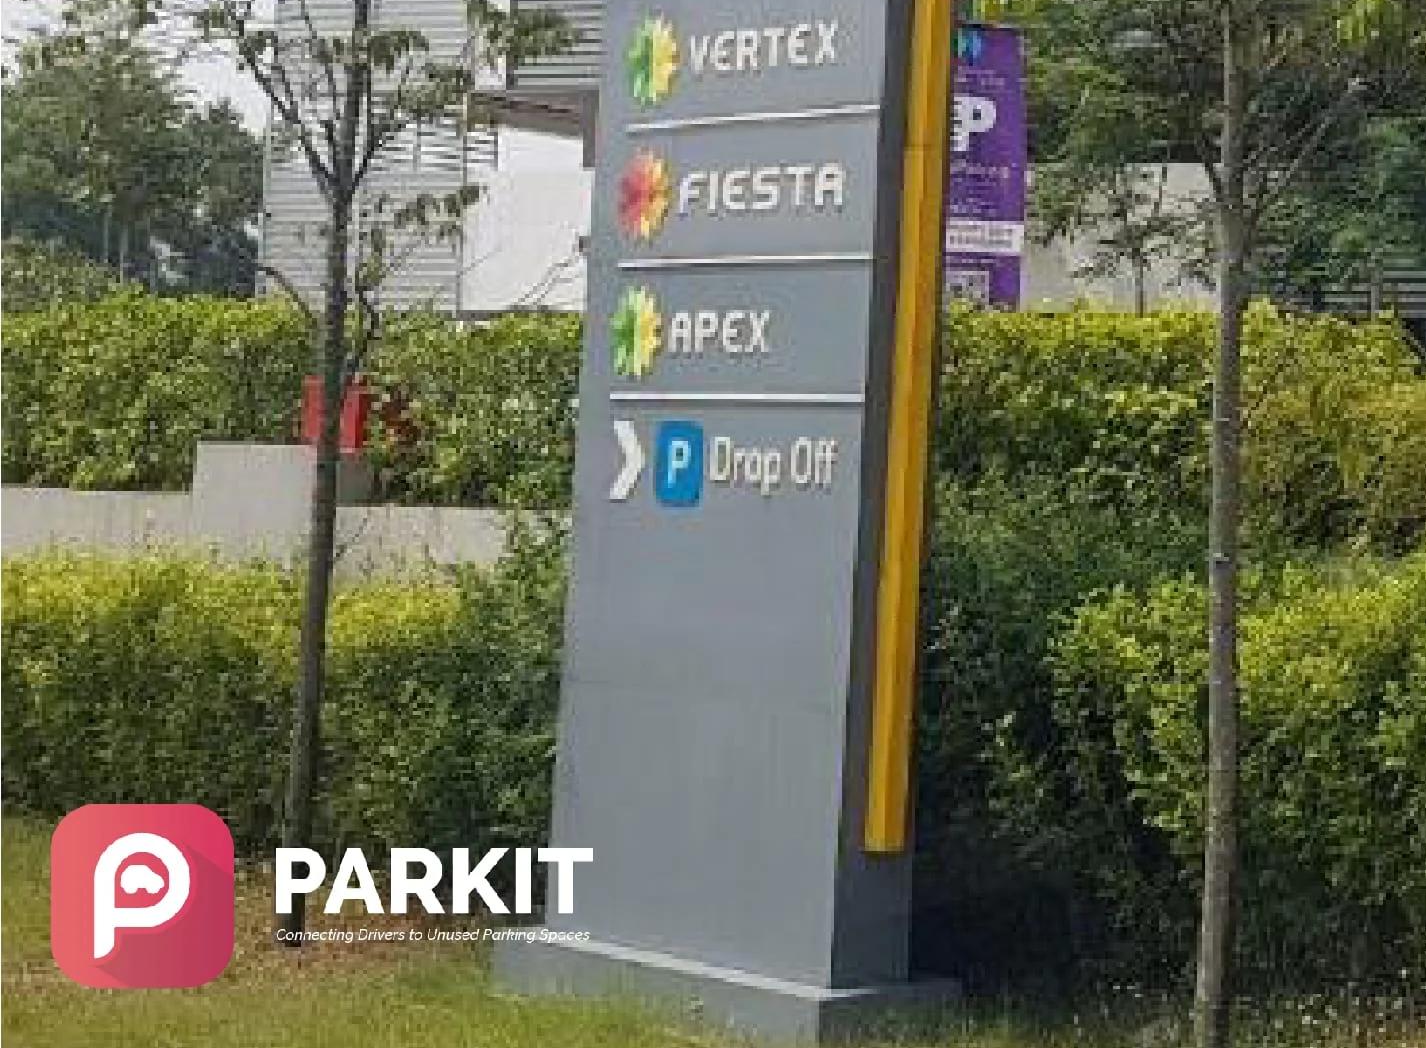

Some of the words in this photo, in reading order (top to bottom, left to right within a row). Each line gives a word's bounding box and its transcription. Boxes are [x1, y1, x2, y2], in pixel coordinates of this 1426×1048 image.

[690, 16, 839, 75] VERTEX
[679, 163, 844, 213] FIESTA
[670, 309, 770, 353] APEX
[709, 436, 782, 497] Drop
[790, 436, 839, 485] Off
